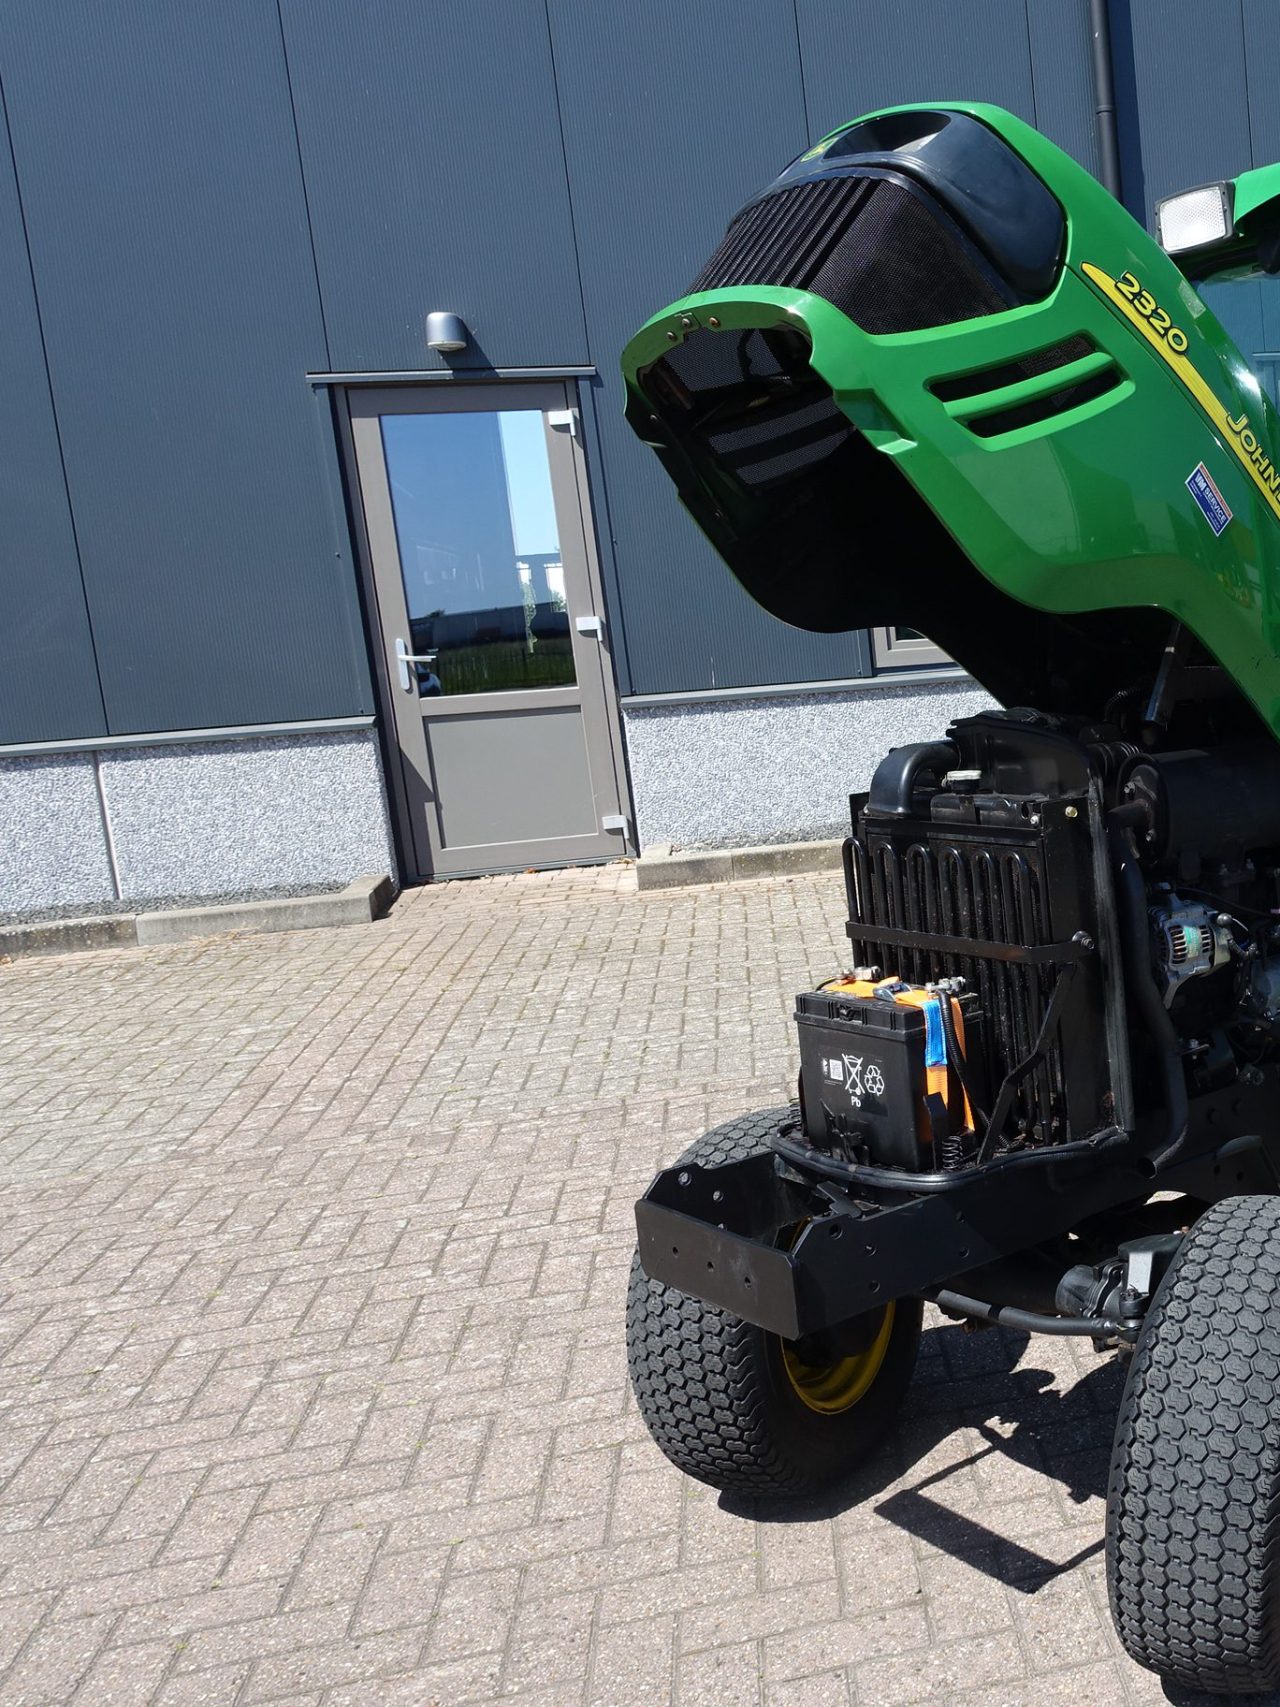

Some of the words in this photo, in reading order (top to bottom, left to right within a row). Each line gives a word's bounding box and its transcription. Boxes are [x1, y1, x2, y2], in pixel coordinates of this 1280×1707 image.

[1115, 271, 1188, 353] 2320
[1227, 413, 1280, 493] JOHN
[1204, 487, 1227, 525] SERVICE
[850, 1096, 861, 1107] Pb
